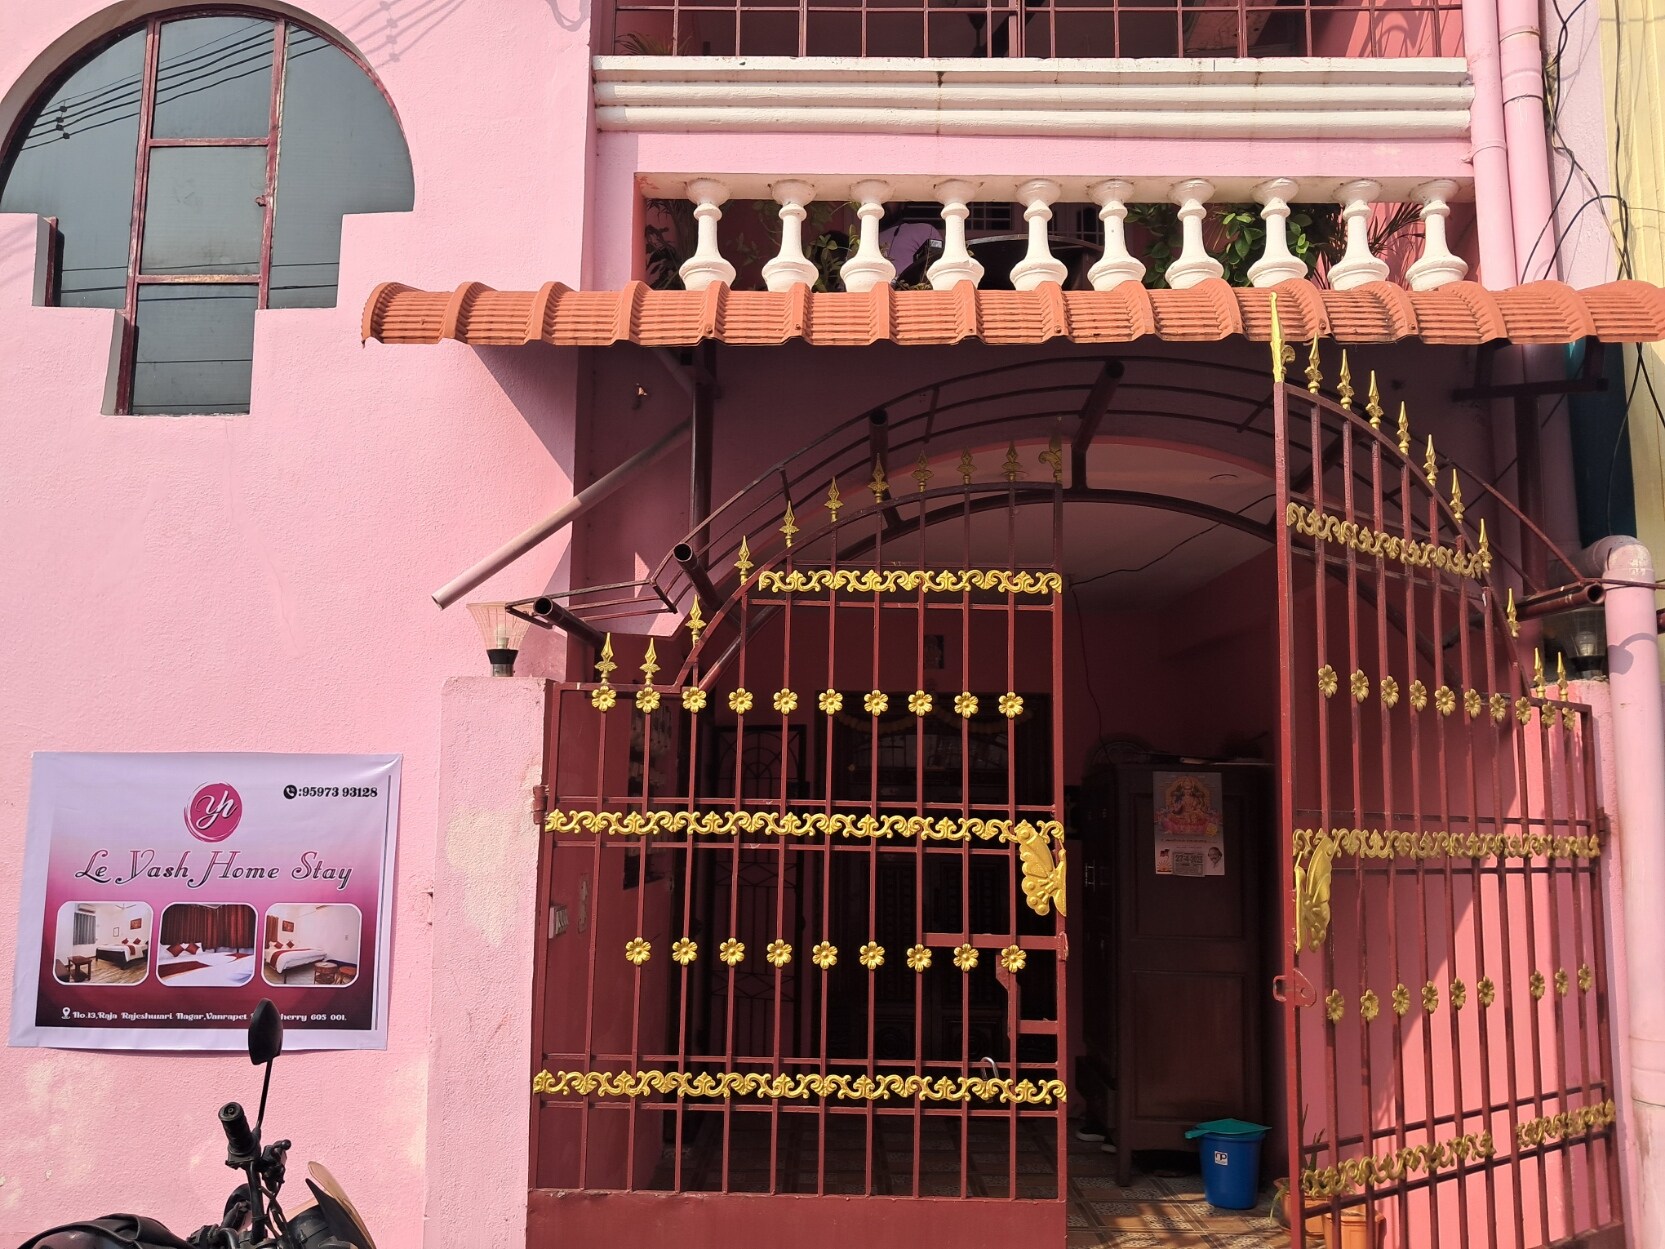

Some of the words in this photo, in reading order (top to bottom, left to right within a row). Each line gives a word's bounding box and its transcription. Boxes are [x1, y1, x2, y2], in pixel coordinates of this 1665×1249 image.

[342, 787, 378, 797] 93128
[75, 849, 112, 884] Le
[187, 850, 280, 888] Home
[291, 850, 353, 890] Stay
[121, 1012, 173, 1021] Rajeshwari
[310, 1013, 327, 1021] 605
